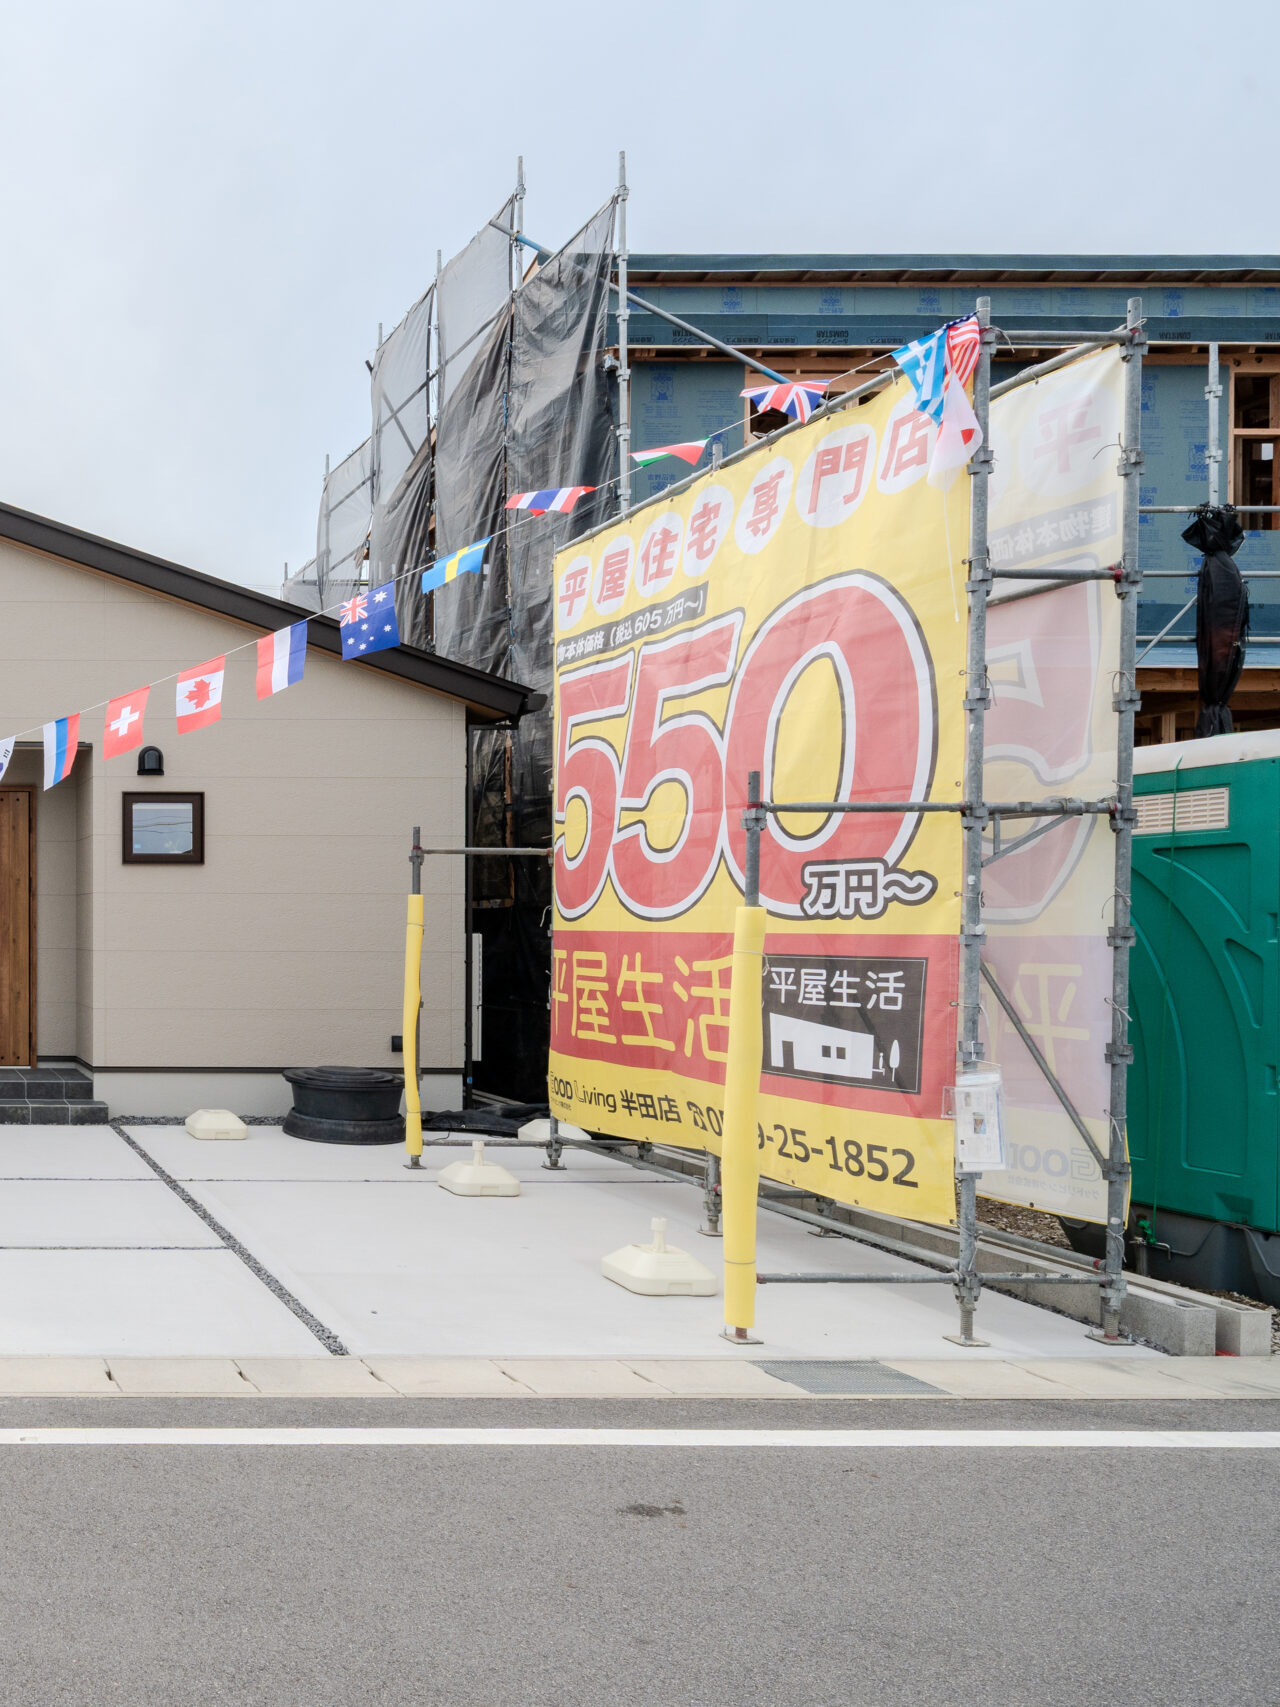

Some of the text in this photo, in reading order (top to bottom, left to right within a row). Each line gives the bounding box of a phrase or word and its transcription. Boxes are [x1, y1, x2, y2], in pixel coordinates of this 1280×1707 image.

[558, 409, 932, 617] 平屋住宅専門店
[554, 569, 939, 922] 550
[553, 949, 733, 1063] 平屋生活
[769, 967, 906, 1011] 平屋生活
[574, 1079, 617, 1113] Living
[619, 1089, 682, 1124] 半田店
[706, 1105, 919, 1188] 0-25-1852
